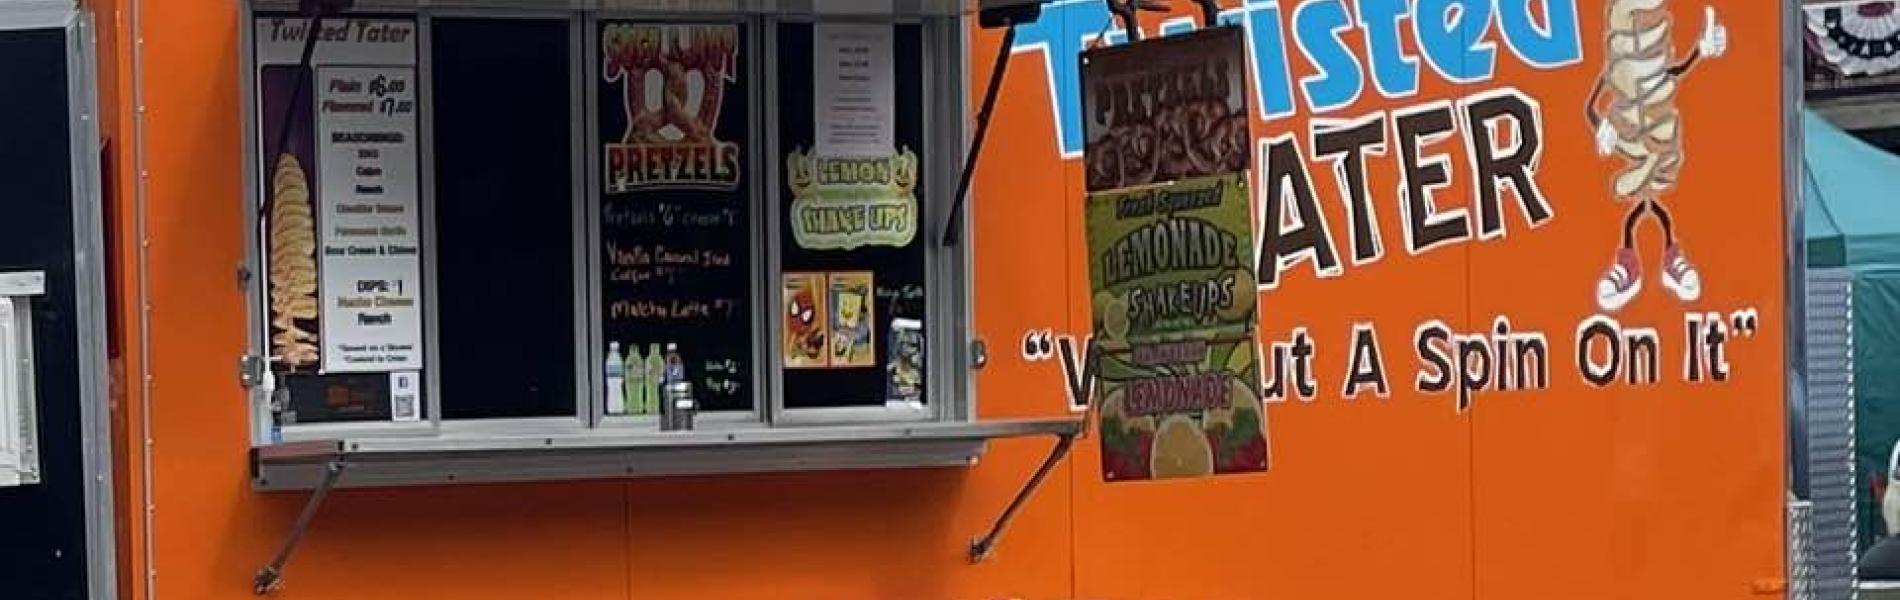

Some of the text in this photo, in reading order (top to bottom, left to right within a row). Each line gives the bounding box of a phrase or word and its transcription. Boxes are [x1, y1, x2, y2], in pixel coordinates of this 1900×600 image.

[356, 22, 411, 43] Tater
[1012, 0, 1583, 159] Tisted
[608, 146, 739, 186] PRETZELS
[818, 158, 890, 185] LEMON
[1256, 87, 1554, 290] ATER
[868, 204, 907, 233] UPS
[1104, 217, 1238, 287] LEMONADE
[1259, 327, 1316, 400] ut
[1344, 321, 1390, 399] A
[1414, 314, 1548, 413] Spin
[1576, 314, 1660, 387] On
[1125, 374, 1234, 417] LEMONADE
